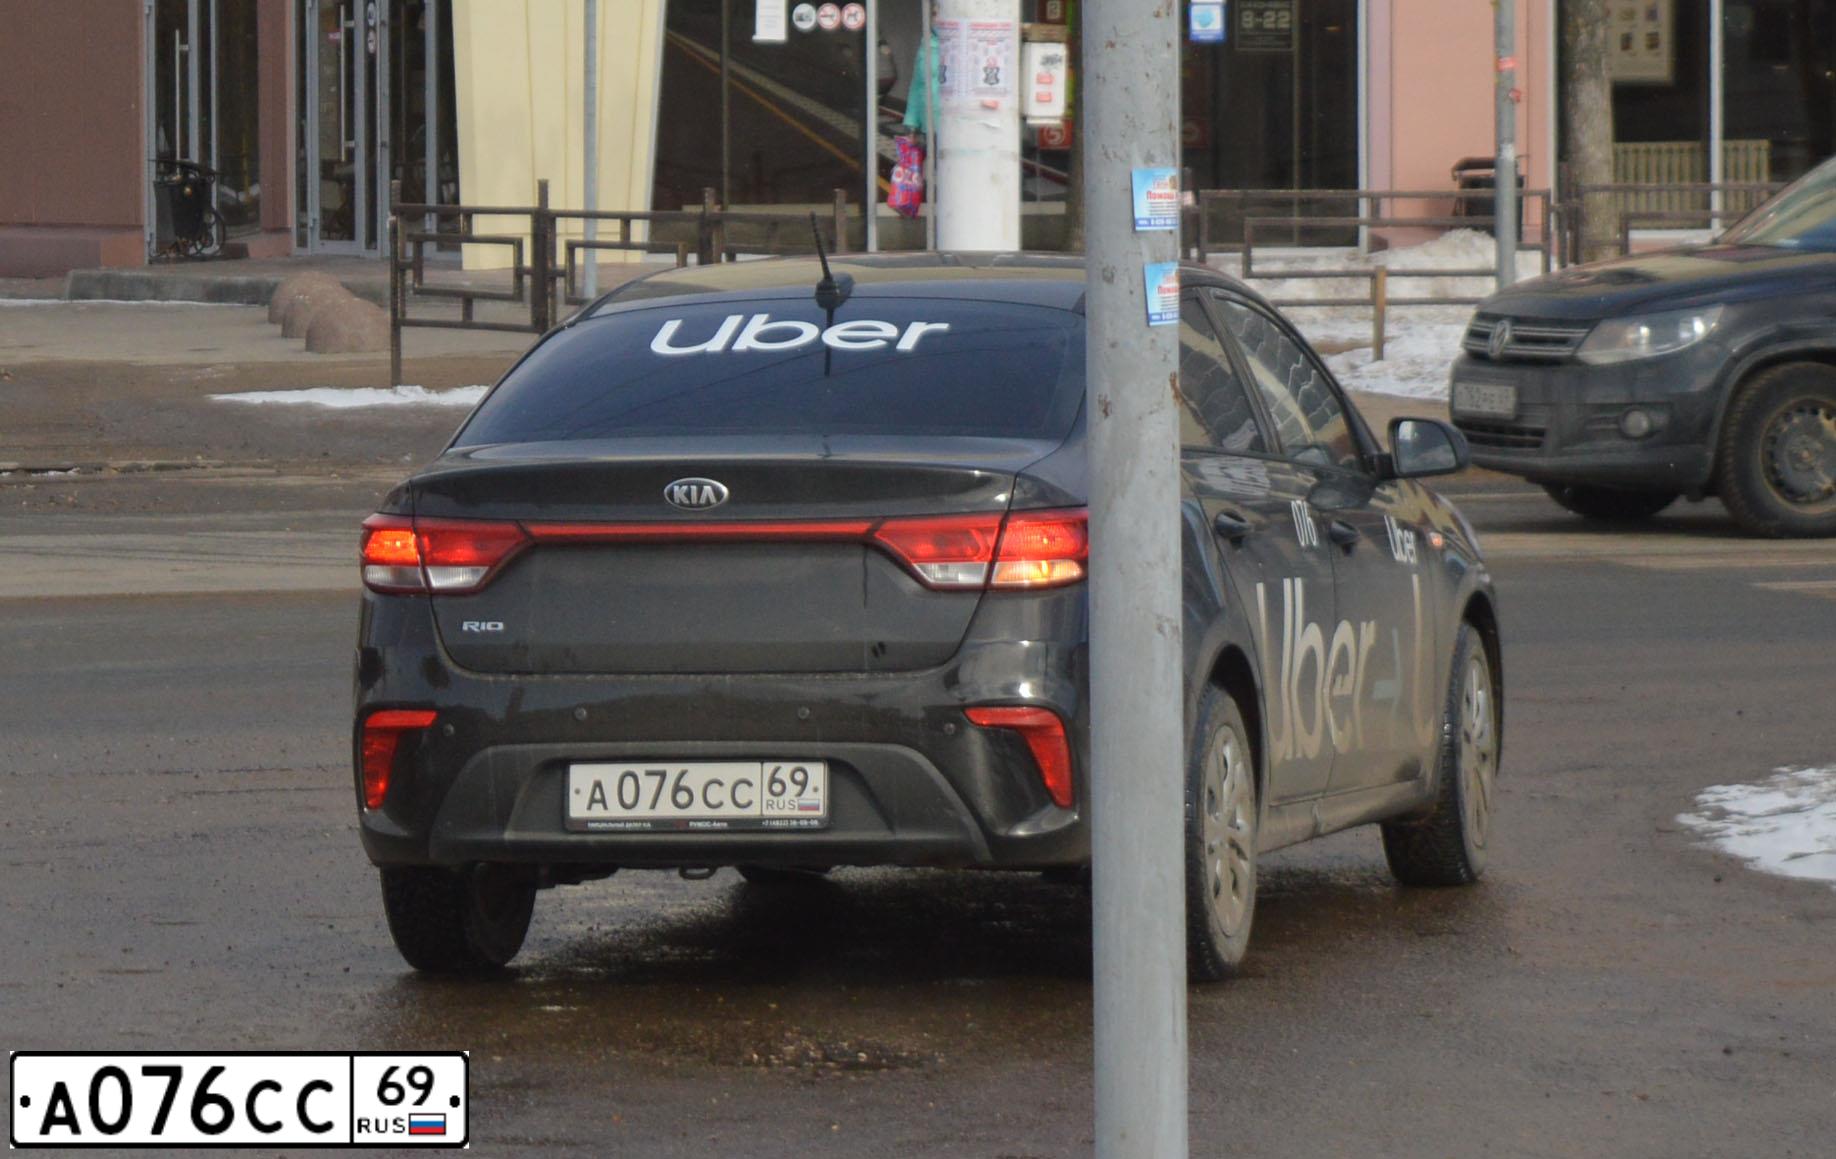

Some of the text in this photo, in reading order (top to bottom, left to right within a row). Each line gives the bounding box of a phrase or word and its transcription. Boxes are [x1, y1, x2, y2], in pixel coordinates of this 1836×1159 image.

[650, 313, 950, 355] Uber
[673, 485, 717, 504] KIA
[462, 621, 504, 632] RIO
[1256, 577, 1375, 766] Uber
[767, 765, 809, 797] 69
[765, 799, 797, 811] RUS
